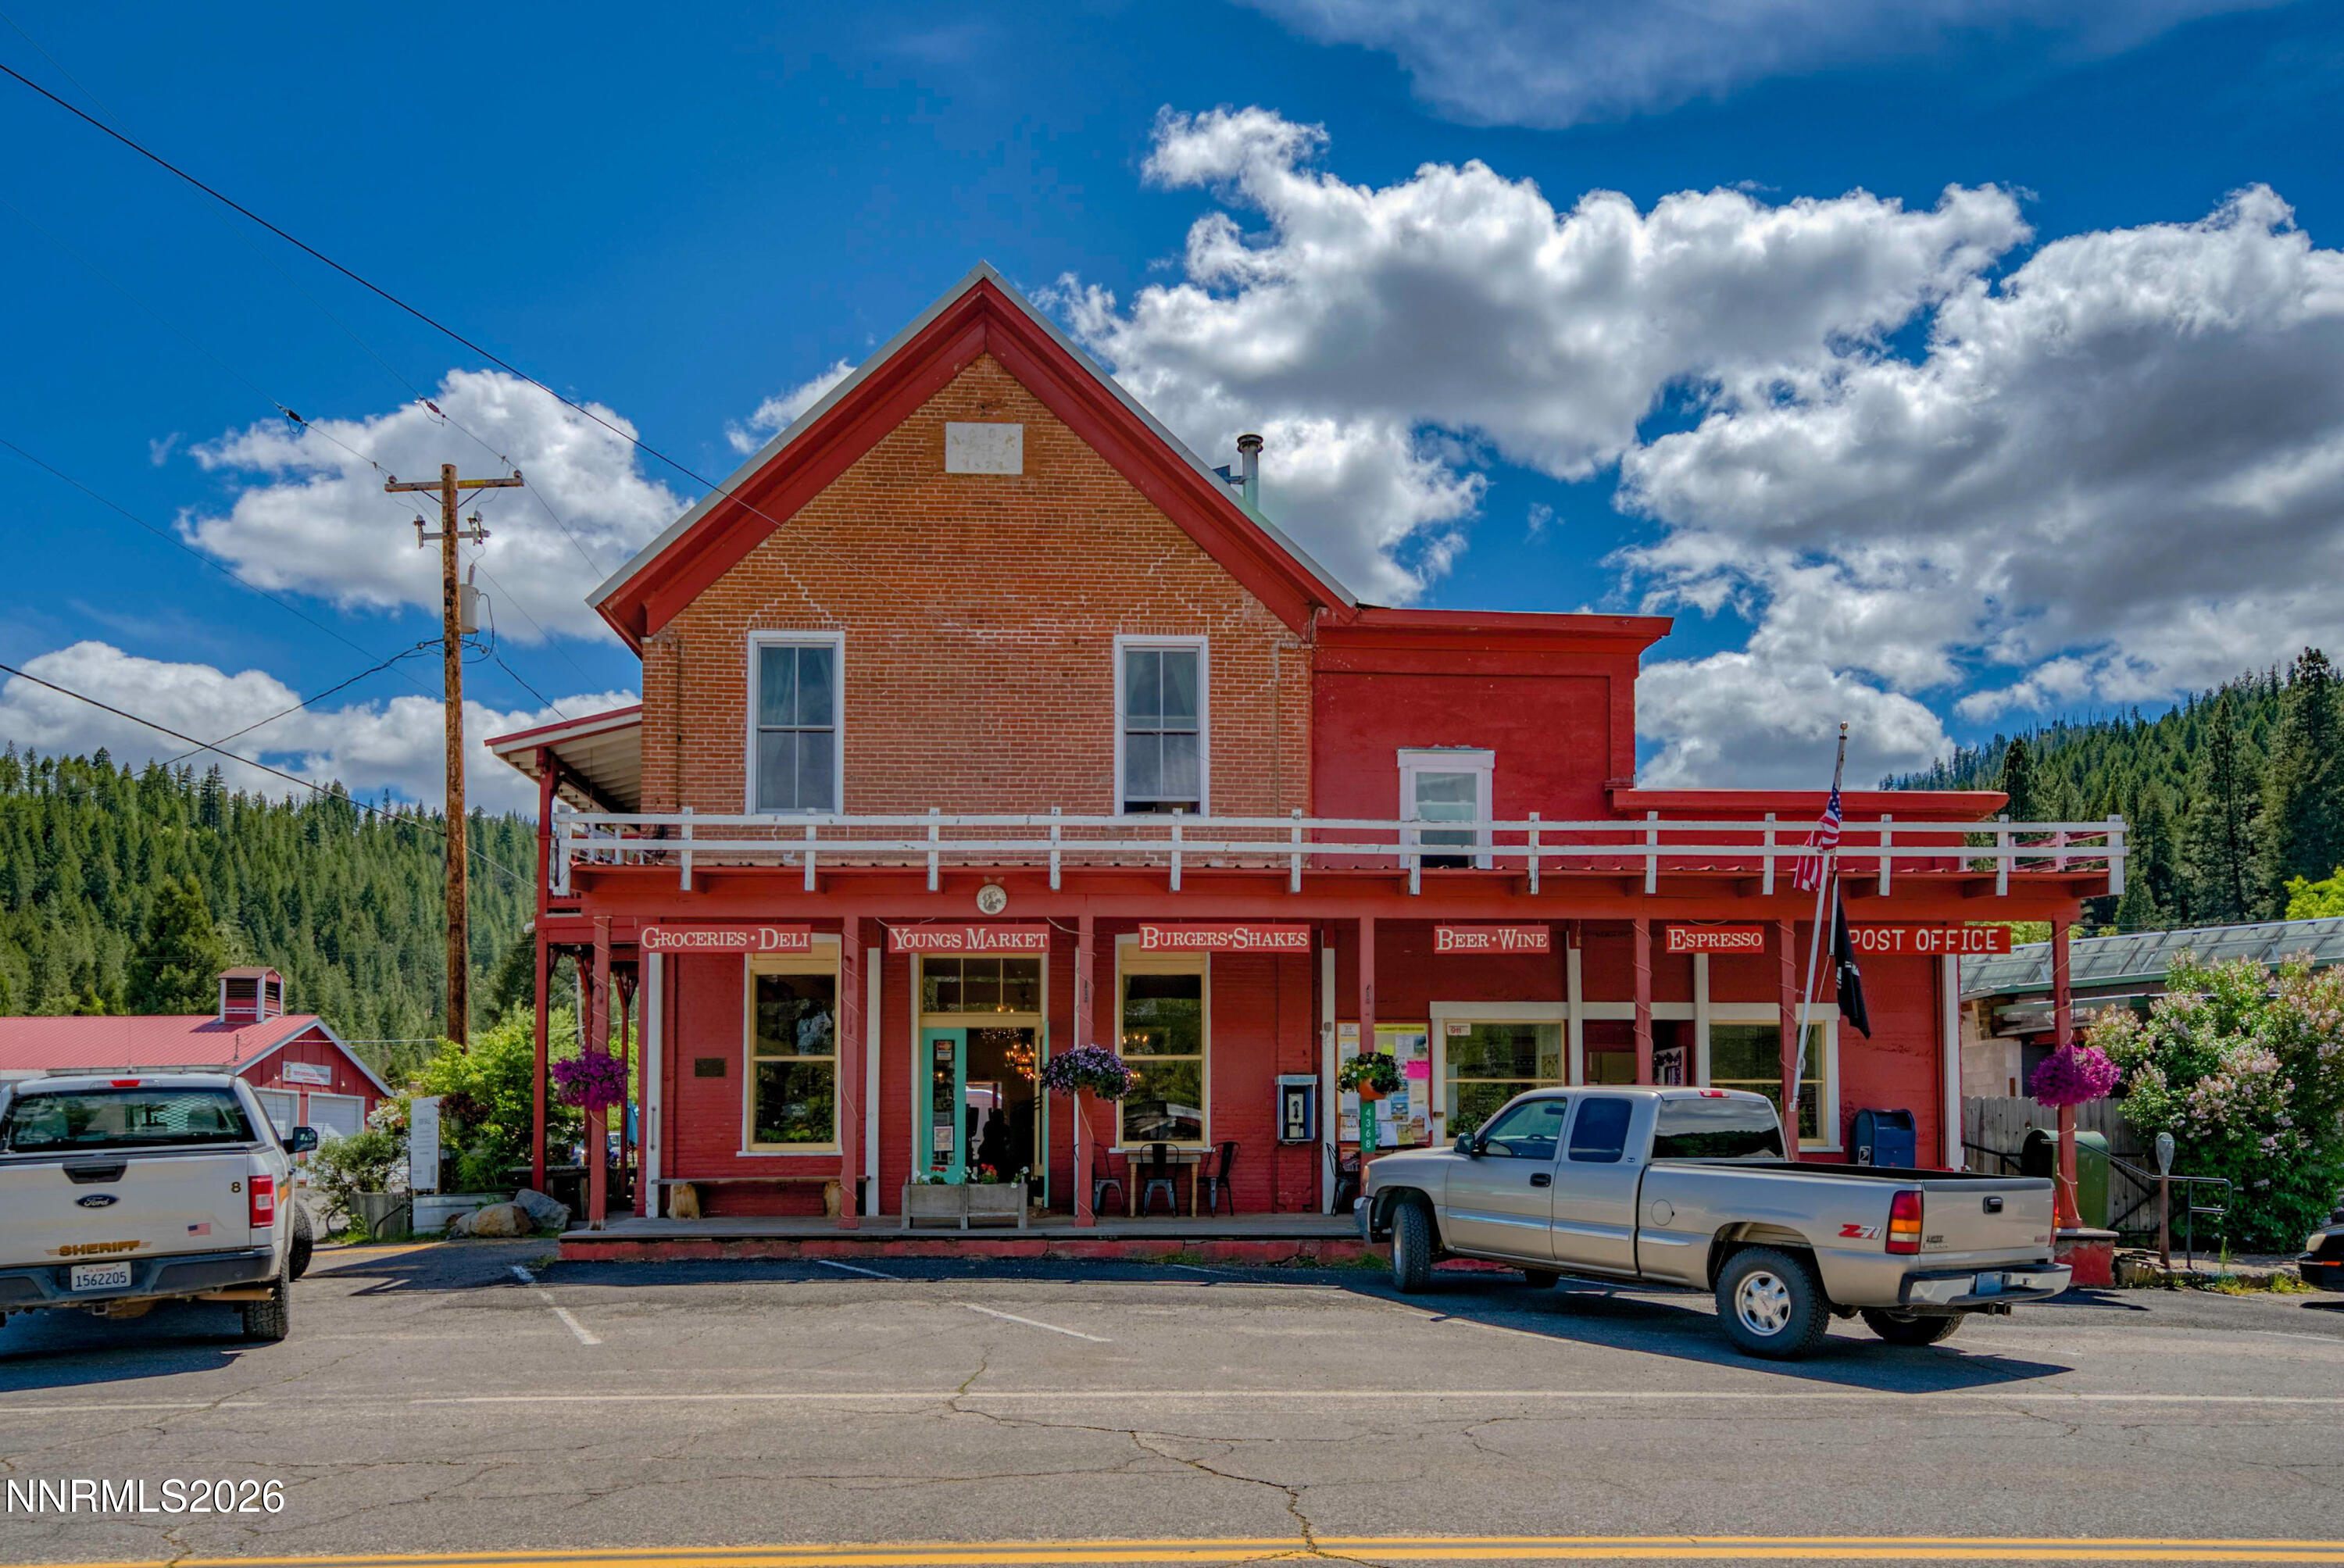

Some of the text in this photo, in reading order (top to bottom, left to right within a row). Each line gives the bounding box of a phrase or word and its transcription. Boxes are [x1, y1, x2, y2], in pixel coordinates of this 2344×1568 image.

[641, 927, 809, 950] GROCERIES DELI
[889, 927, 1048, 950] YOUNG'S MARKET
[1141, 927, 1308, 949] BURGERS SHAKES
[1436, 928, 1548, 951] BEER WINE
[1668, 929, 1763, 950] ESPRESSO
[1848, 928, 1999, 951] POST OFFICE
[231, 1181, 241, 1193] 8
[84, 1196, 110, 1207] Ford
[1838, 1223, 1881, 1240] Z71
[59, 1240, 141, 1256] SHERIFF
[76, 1271, 127, 1288] 1562205
